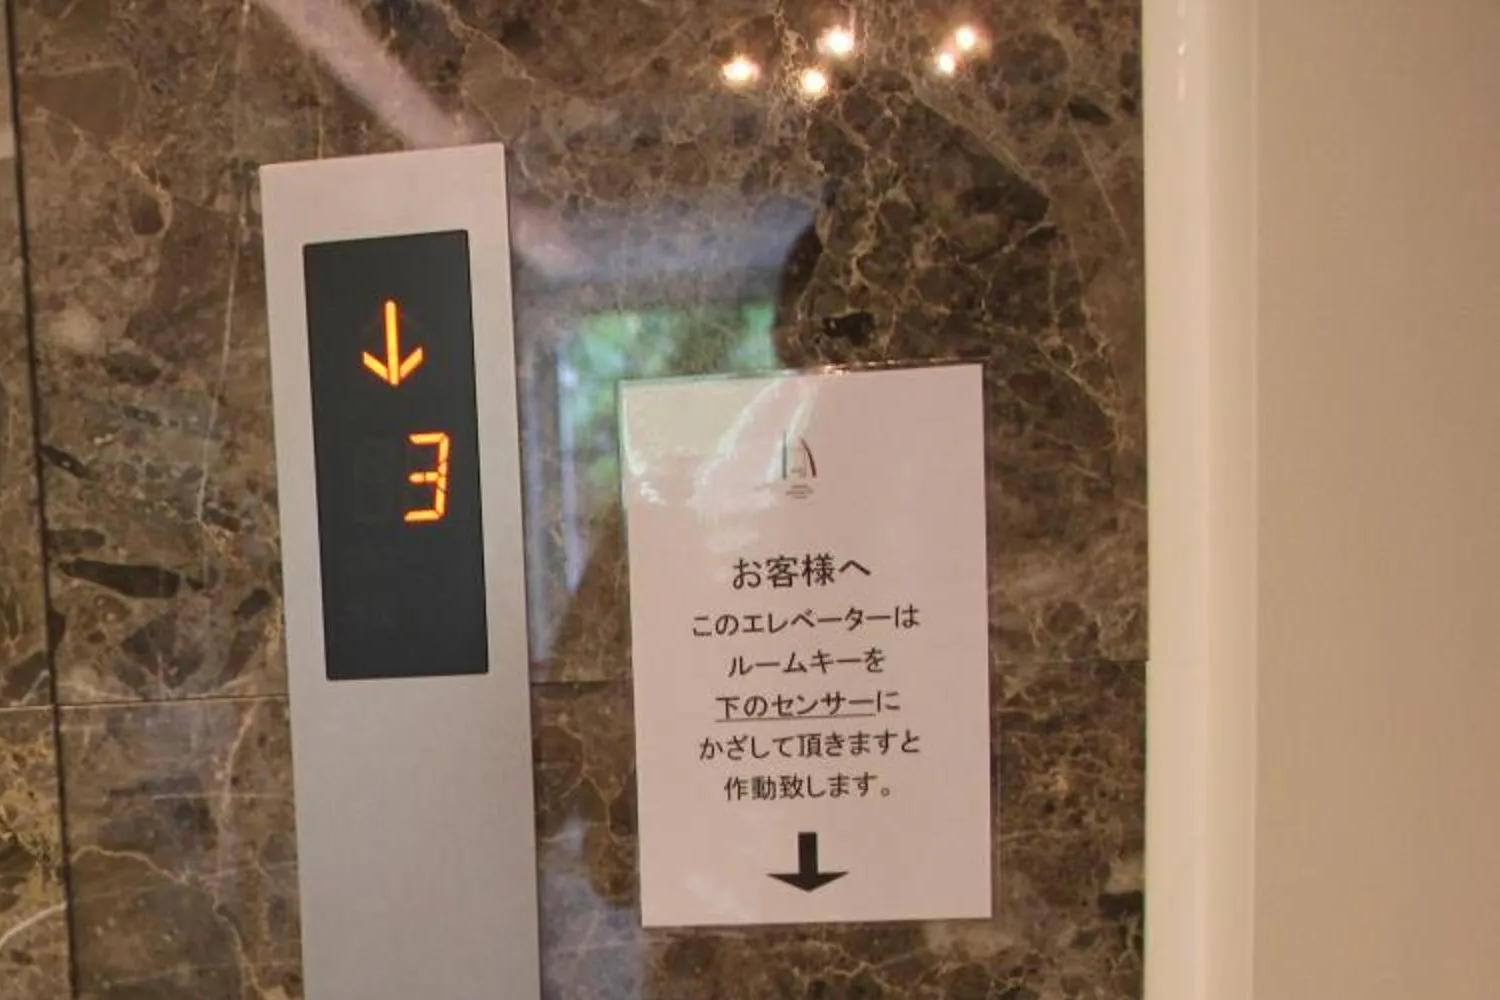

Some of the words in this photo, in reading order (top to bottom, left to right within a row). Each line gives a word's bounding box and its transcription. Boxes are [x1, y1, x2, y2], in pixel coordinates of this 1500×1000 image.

[403, 431, 450, 522] 3
[732, 552, 872, 590] お客様へ
[692, 603, 921, 637] このエレベーターは
[727, 647, 886, 678] ルームキーを
[714, 690, 901, 720] 下のセンサーに
[699, 728, 920, 761] かざして頂きますと
[723, 771, 891, 801] 作動致します。
